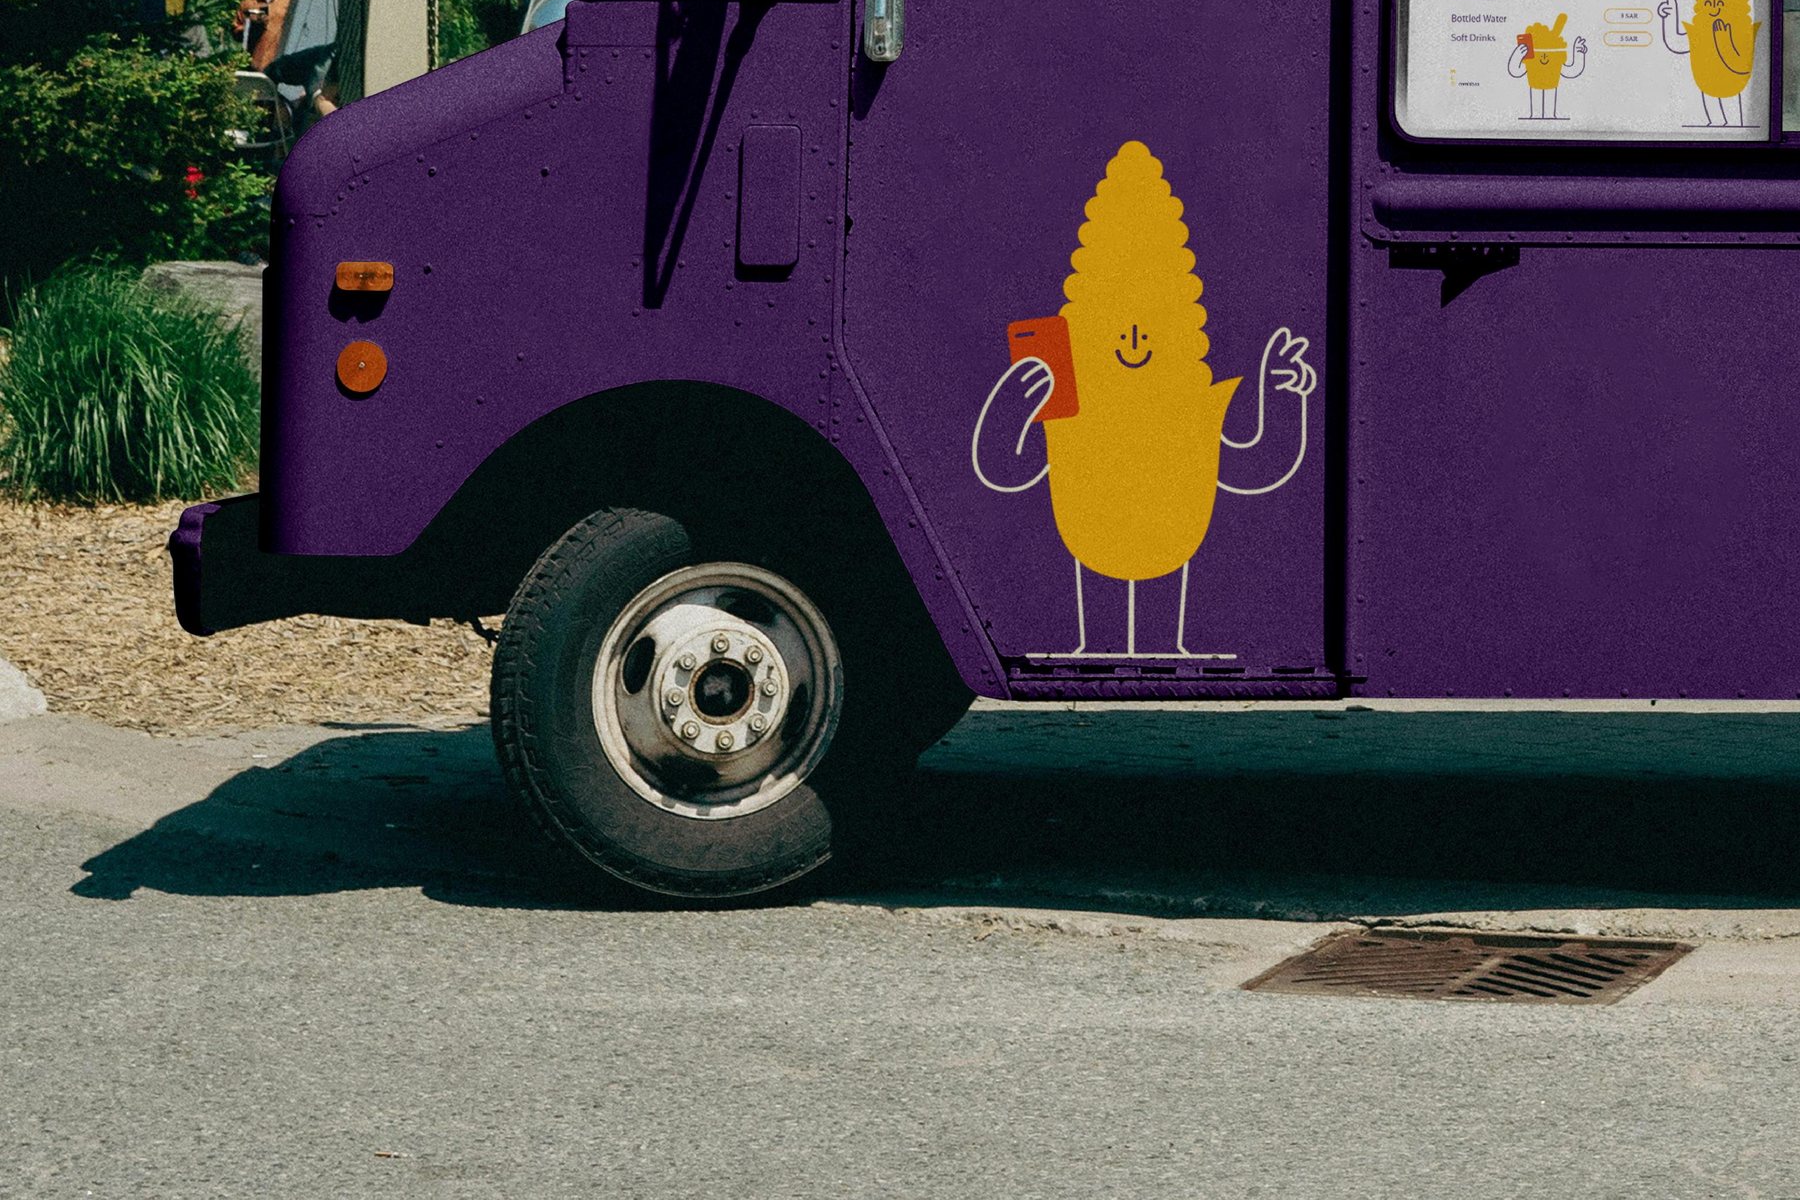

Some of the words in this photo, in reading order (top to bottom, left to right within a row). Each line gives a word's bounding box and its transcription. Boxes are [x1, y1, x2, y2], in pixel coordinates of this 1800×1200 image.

[1451, 14, 1481, 23] Bottled
[1483, 14, 1507, 23] Water
[1451, 34, 1468, 42] Soft
[1469, 34, 1496, 42] Drinks
